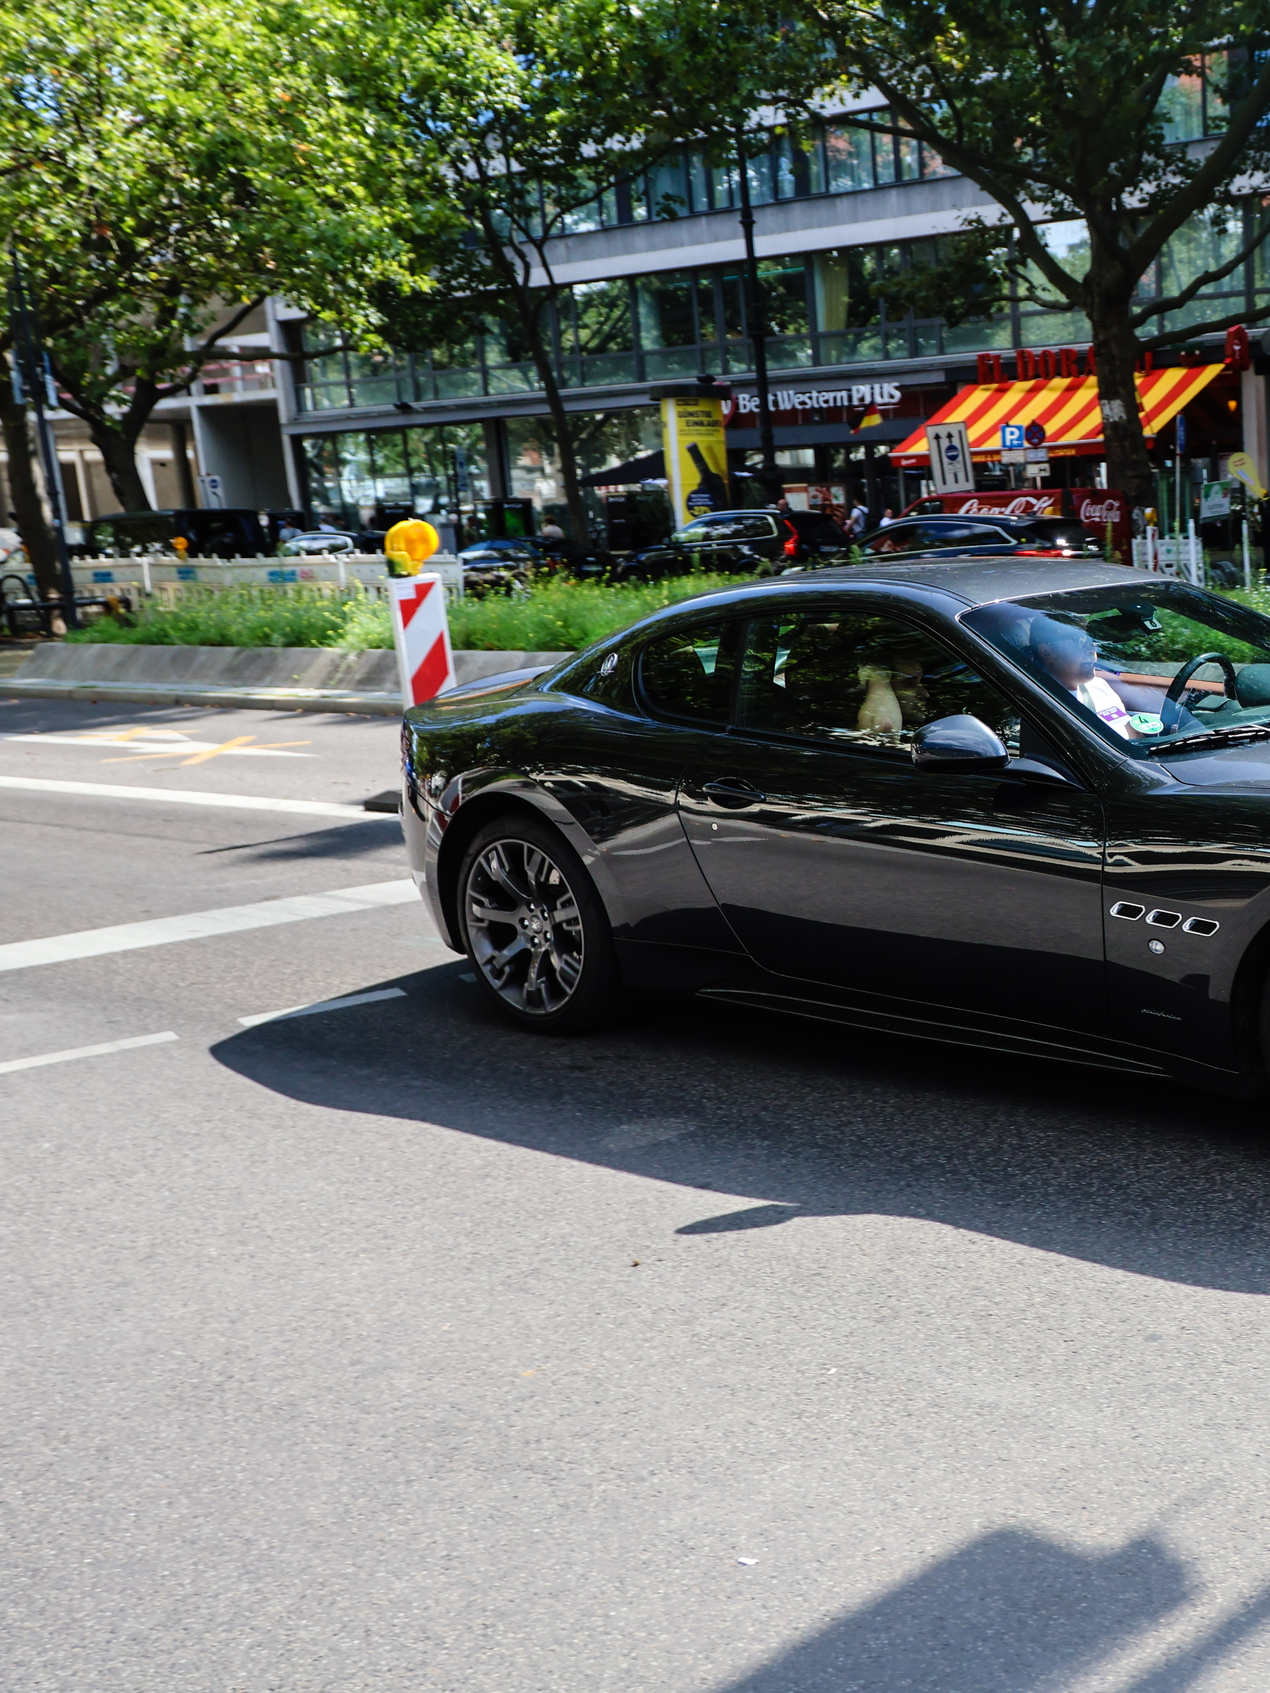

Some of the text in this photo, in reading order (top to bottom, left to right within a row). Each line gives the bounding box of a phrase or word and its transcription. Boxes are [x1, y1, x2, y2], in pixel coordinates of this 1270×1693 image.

[977, 345, 1154, 386] EL DORAO
[738, 393, 776, 413] Bet
[776, 389, 849, 411] Western
[851, 382, 902, 405] PLUS
[1005, 427, 1019, 446] P
[1080, 498, 1122, 523] Coca-Cola
